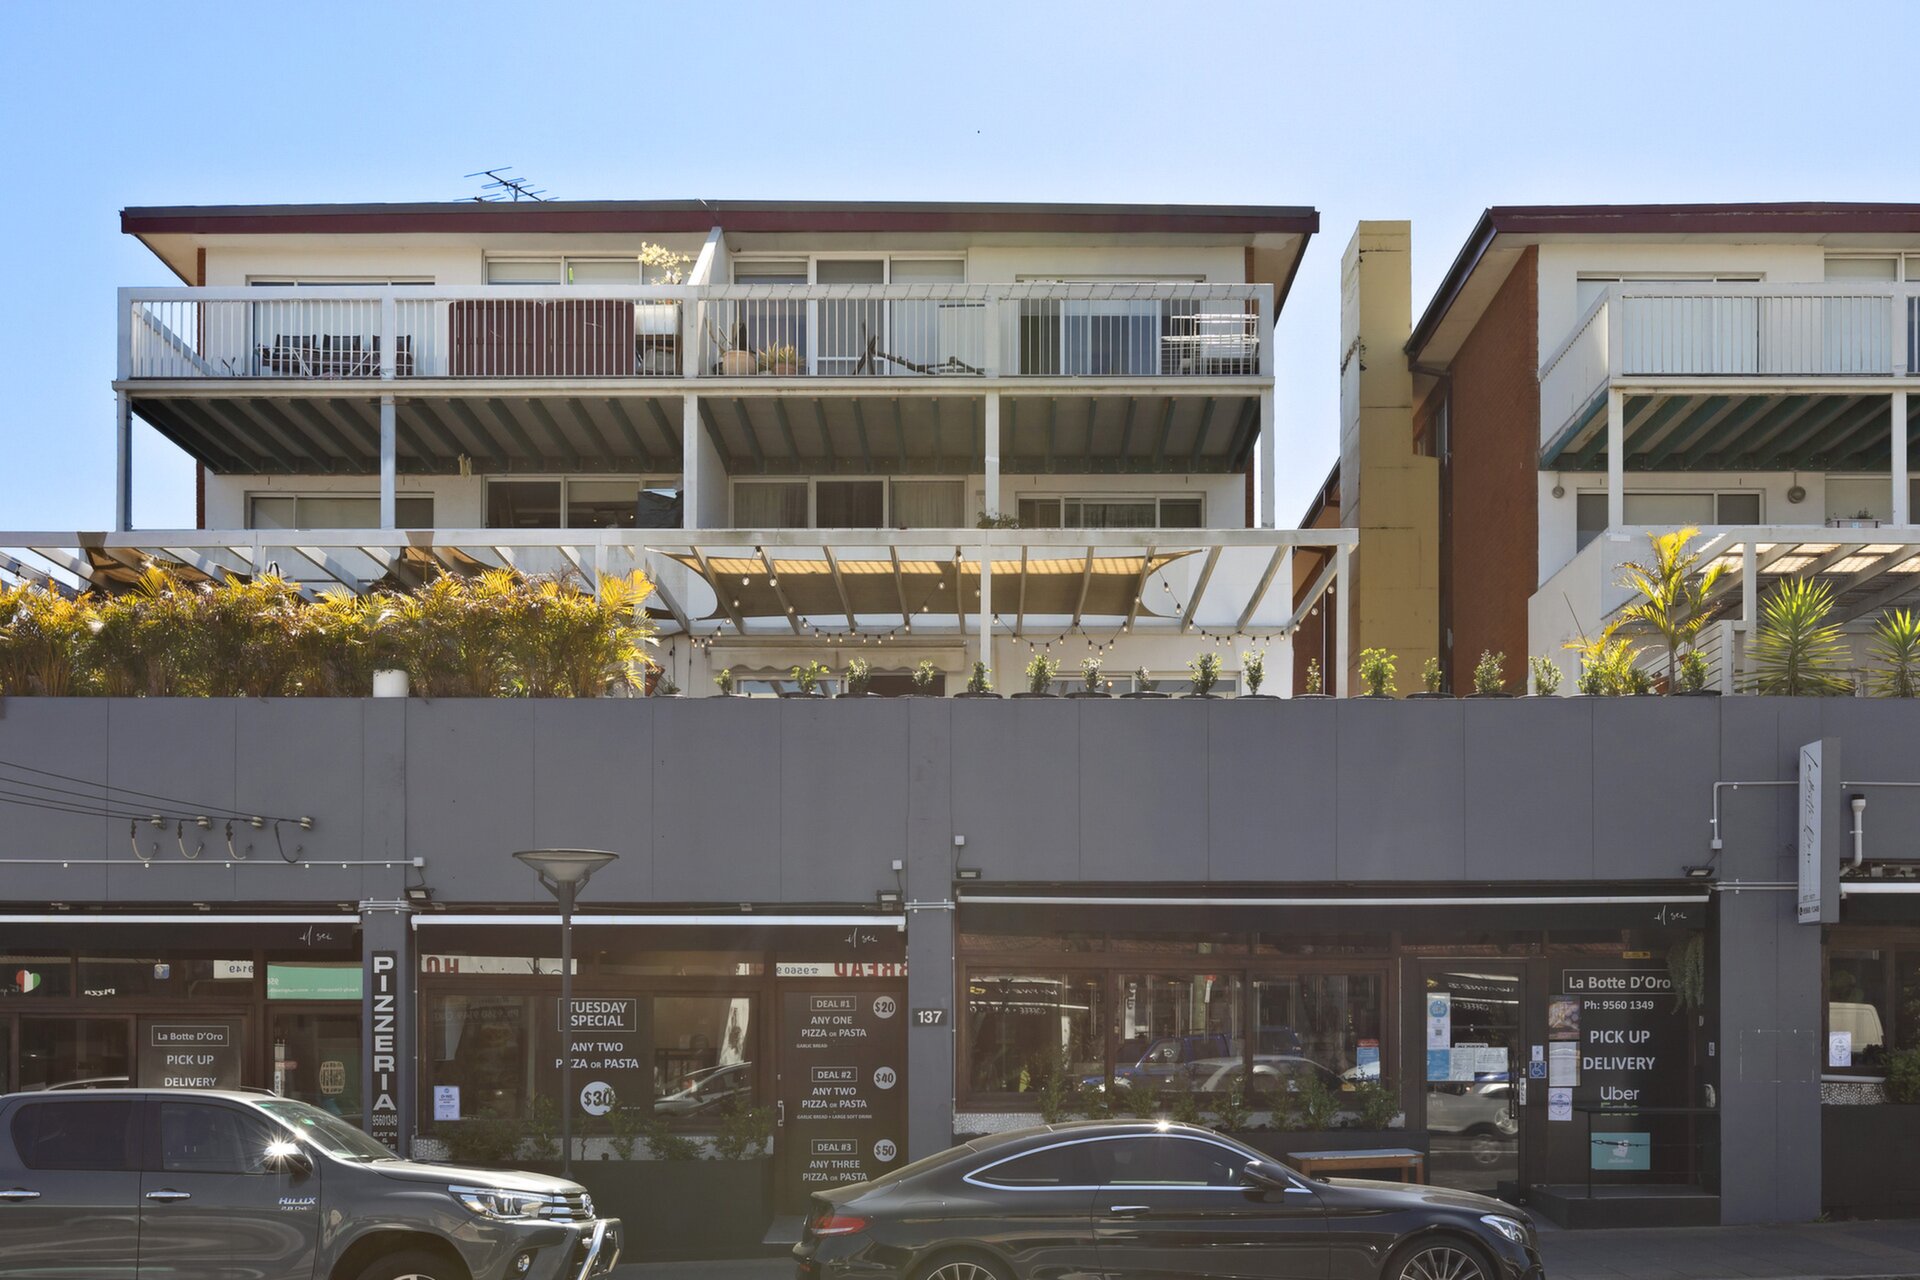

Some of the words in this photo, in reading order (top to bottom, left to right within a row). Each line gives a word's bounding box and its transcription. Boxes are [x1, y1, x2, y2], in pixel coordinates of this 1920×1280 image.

[1569, 976, 1584, 989] La
[1589, 976, 1626, 989] Botte
[570, 1001, 627, 1013] TUESDAY
[875, 1002, 894, 1013] $20
[1584, 1000, 1600, 1010] Ph:
[1602, 1000, 1627, 1010] 9560
[1630, 1000, 1654, 1010] 1349
[570, 1015, 624, 1026] SPECIAL
[810, 1016, 830, 1025] ANY
[833, 1016, 852, 1025] ONE
[917, 1010, 943, 1024] 137
[157, 1032, 167, 1041] La
[169, 1032, 195, 1041] Botte
[373, 956, 397, 1111] PIZZERIA
[801, 1028, 827, 1037] PIZZA
[839, 1028, 867, 1037] PASTA
[1590, 1030, 1625, 1044] PICK
[1629, 1030, 1651, 1044] UP
[570, 1042, 594, 1052] ANY
[597, 1042, 624, 1052] TWO
[166, 1054, 194, 1065] PICK
[197, 1054, 215, 1065] UP
[590, 1061, 601, 1069] OR
[604, 1058, 639, 1069] PASTA
[1582, 1056, 1656, 1071] DELIVERY
[818, 1071, 839, 1079] DEAL
[841, 1071, 851, 1079] #2
[875, 1072, 894, 1084] $40
[164, 1077, 217, 1087] DELIVERY
[811, 1087, 831, 1096] ANY
[834, 1087, 856, 1096] TWO
[1600, 1085, 1640, 1101] Uber
[584, 1090, 613, 1106] $30
[801, 1099, 827, 1108] PIZZA
[839, 1099, 867, 1108] PASTA
[841, 1143, 851, 1151] #3
[875, 1144, 895, 1157] $50
[809, 1160, 830, 1169] ANY
[831, 1160, 860, 1169] THREE
[802, 1172, 828, 1181] PIZZA
[839, 1172, 868, 1182] PASTA
